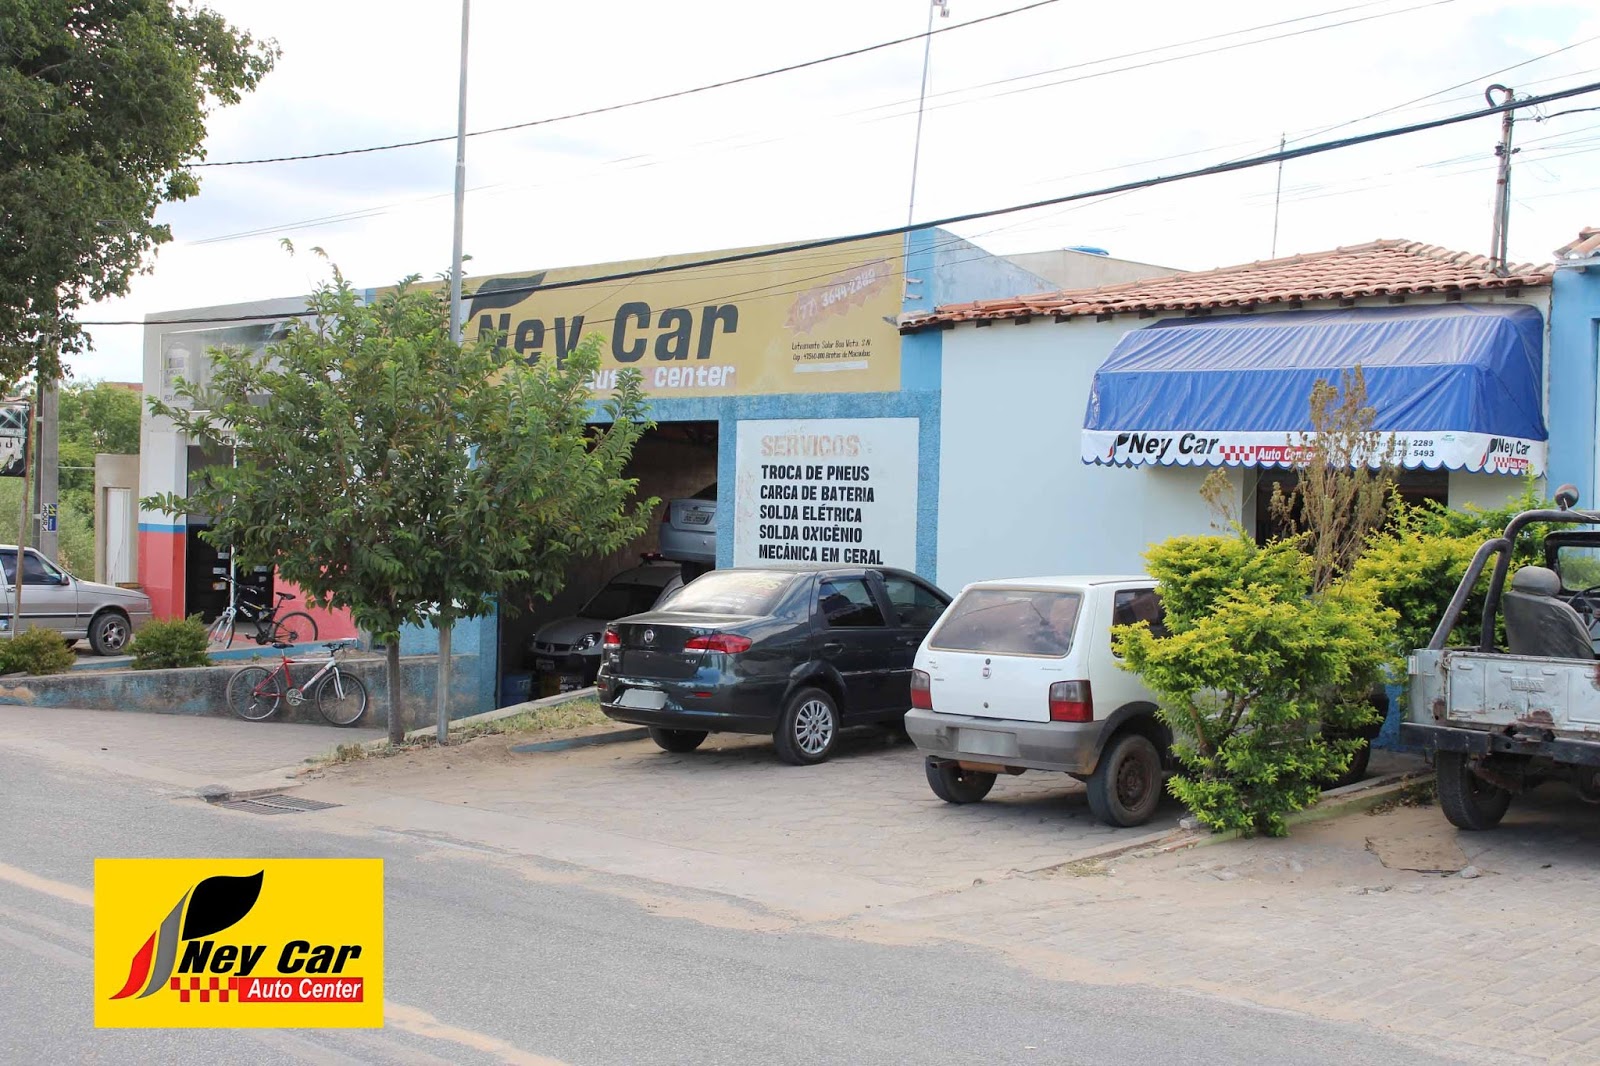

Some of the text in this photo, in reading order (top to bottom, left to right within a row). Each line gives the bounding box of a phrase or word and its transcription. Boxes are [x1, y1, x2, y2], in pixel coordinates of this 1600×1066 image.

[478, 301, 739, 371] Ney Car
[654, 365, 736, 390] center
[1128, 432, 1220, 460] Ney Car
[1413, 439, 1434, 447] 2289
[1497, 438, 1531, 457] Ney Car
[1256, 447, 1281, 461] Auto
[1413, 449, 1435, 457] 5493
[761, 465, 870, 481] TROCA DE PNEUS
[760, 485, 875, 502] CARGA DE BATERIA
[759, 503, 862, 523] SOLDA ELÉTRICA
[759, 524, 863, 543] SOLDA OXIGÊNIO
[758, 542, 884, 565] MECÂNICA EM GERAL
